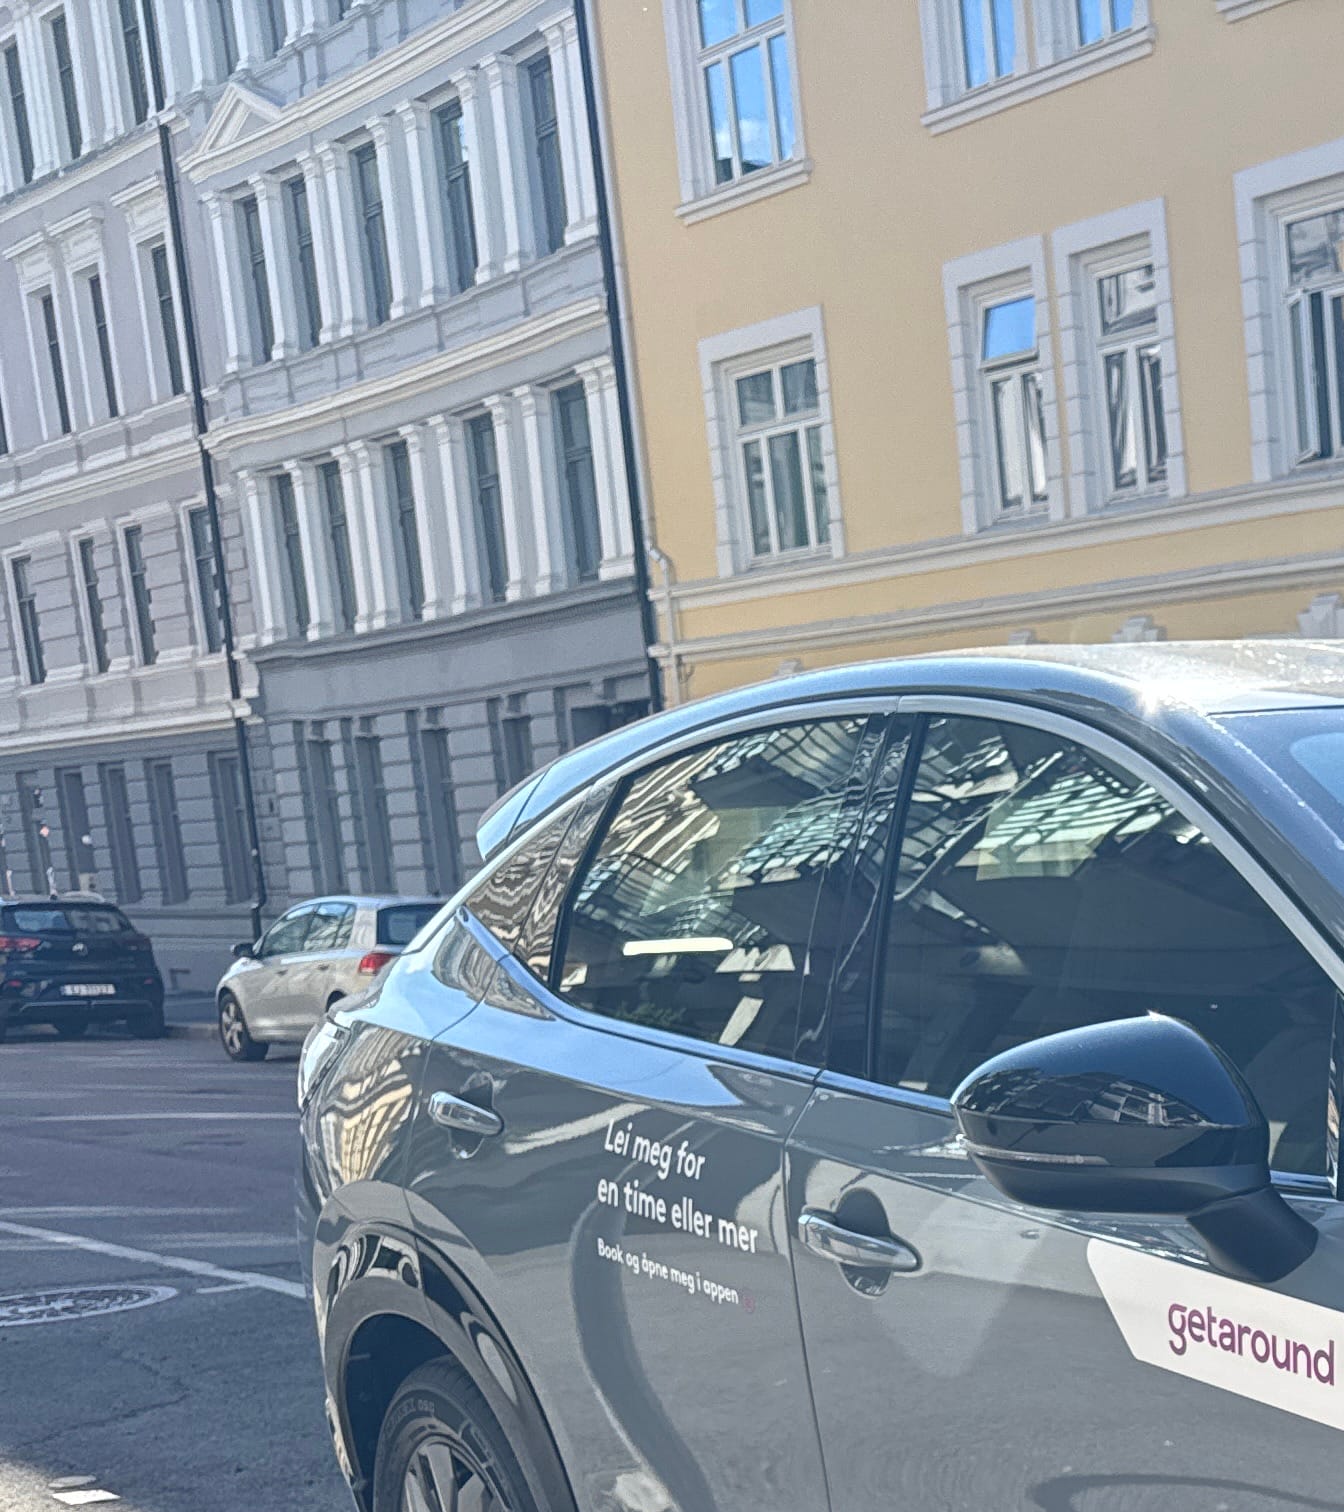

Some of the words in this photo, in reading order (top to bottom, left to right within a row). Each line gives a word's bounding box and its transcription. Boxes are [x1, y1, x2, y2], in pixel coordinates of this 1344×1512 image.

[604, 1119, 633, 1156] Lei
[632, 1134, 672, 1180] meg
[676, 1140, 706, 1180] for
[597, 1178, 619, 1207] en
[623, 1179, 667, 1223] time
[671, 1197, 713, 1238] eller
[718, 1218, 758, 1253] mer
[597, 1237, 624, 1264] Book
[626, 1252, 640, 1274] og
[641, 1252, 668, 1279] åpne
[670, 1267, 695, 1294] meg
[696, 1271, 701, 1291] i
[703, 1279, 739, 1304] appen
[1168, 1303, 1335, 1386] getaround
